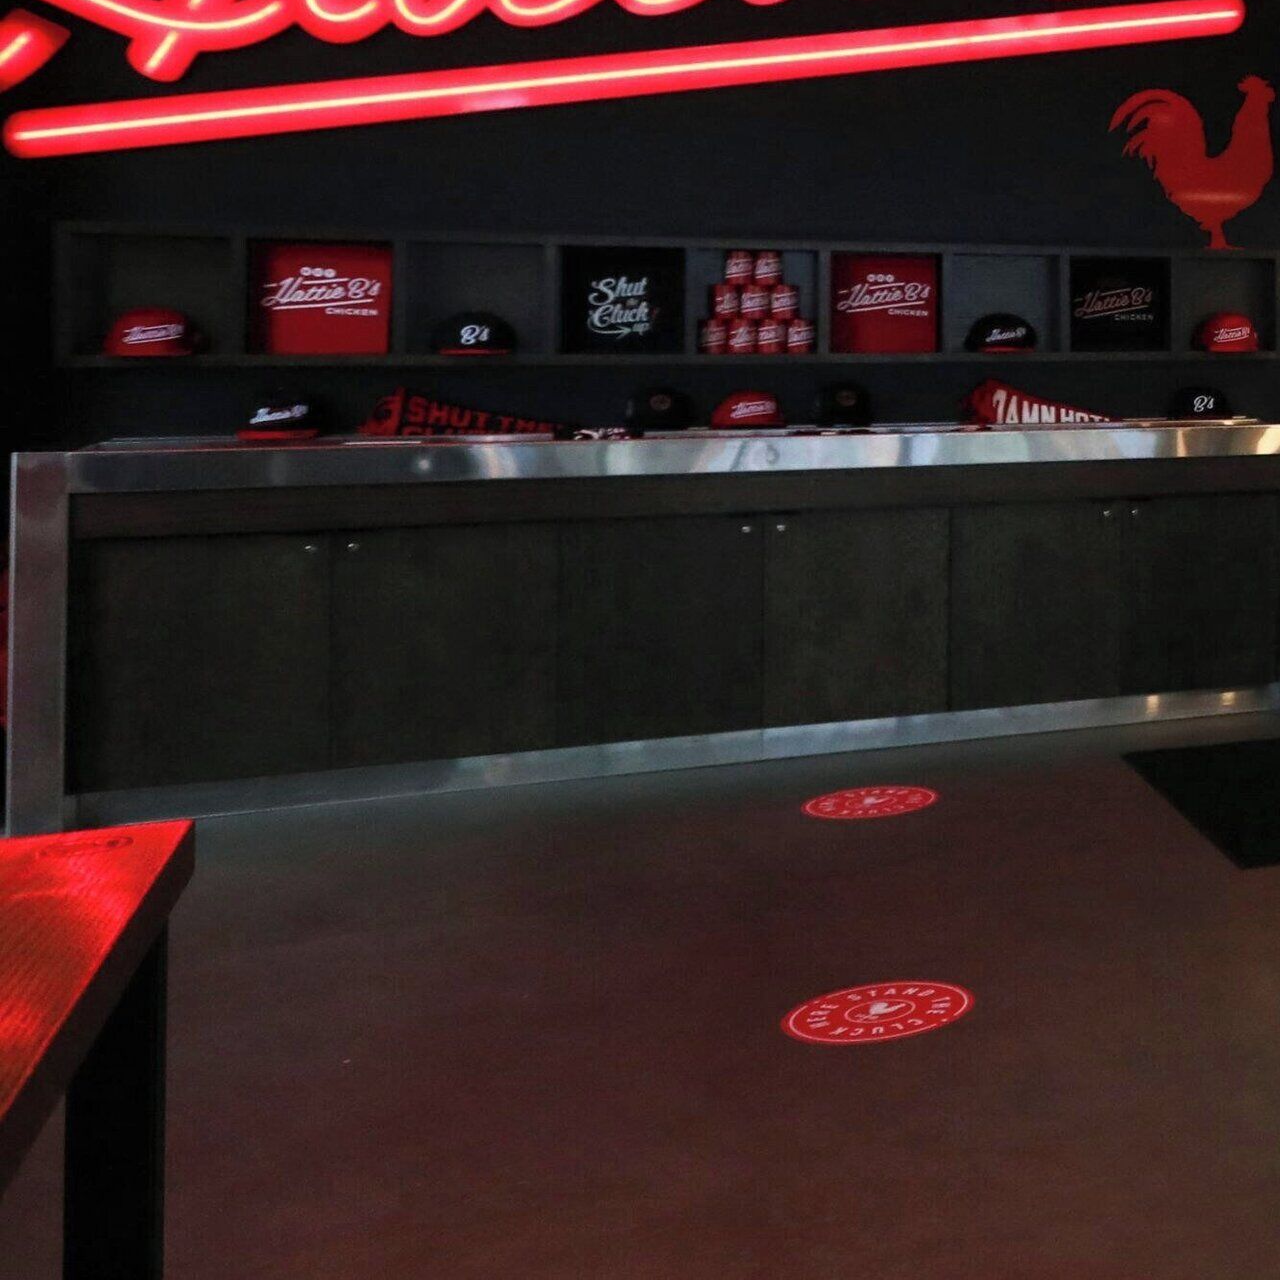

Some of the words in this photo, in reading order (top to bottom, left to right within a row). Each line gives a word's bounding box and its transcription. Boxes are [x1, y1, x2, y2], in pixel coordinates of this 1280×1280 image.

[348, 278, 381, 299] B's
[588, 276, 647, 305] Shut
[837, 284, 904, 310] Hattie
[904, 282, 931, 301] B's
[1075, 290, 1129, 317] Hattie
[459, 325, 490, 345] B's
[408, 396, 490, 426] SHUT
[1193, 396, 1214, 413] B's
[845, 987, 936, 1001] STAND
